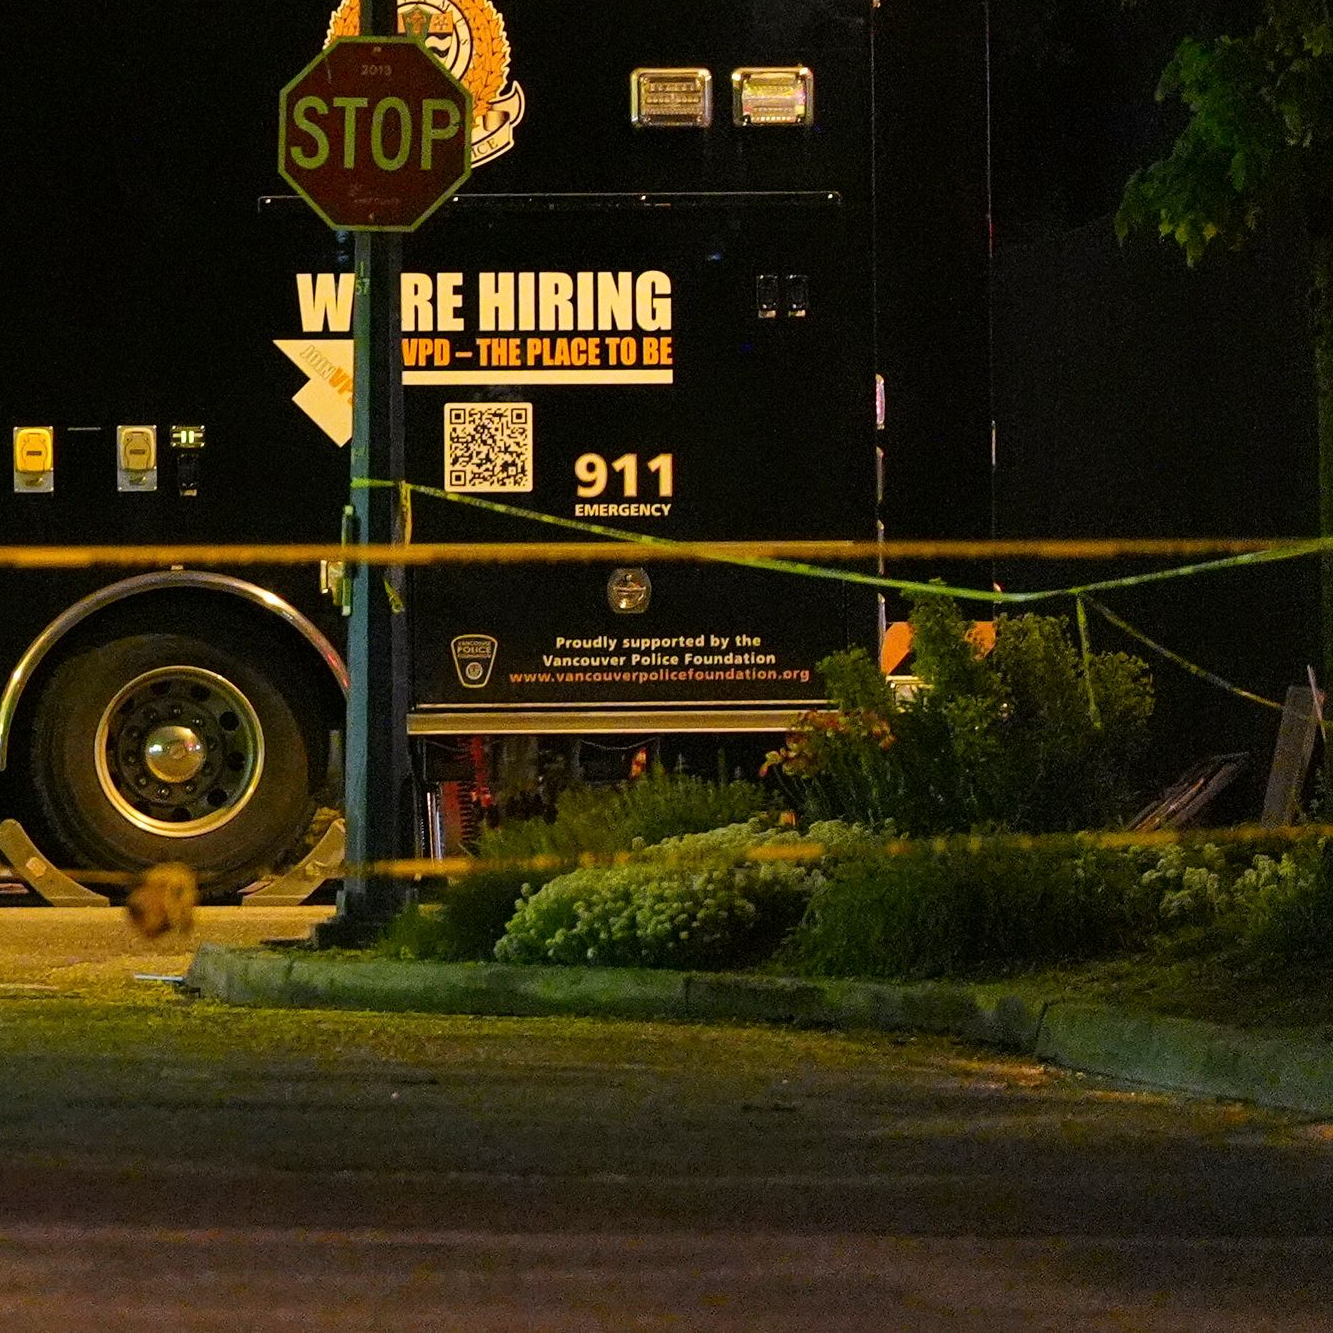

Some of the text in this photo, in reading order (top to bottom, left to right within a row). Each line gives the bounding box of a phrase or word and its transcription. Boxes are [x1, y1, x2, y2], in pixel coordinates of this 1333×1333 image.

[290, 95, 461, 171] STOP
[296, 272, 465, 333] WRE
[478, 270, 672, 332] HIRING
[401, 337, 451, 367] VPD
[475, 337, 521, 367] THE
[527, 337, 601, 366] PLACE
[605, 336, 637, 366] TO
[642, 336, 673, 365] BE
[574, 453, 674, 498] 911
[574, 503, 672, 518] EMERGENCY
[555, 634, 762, 651] Proudly supported by the
[542, 651, 777, 667] Vancouver Police Foundation
[509, 667, 810, 683] www.vancouverpolicefoundation.org
